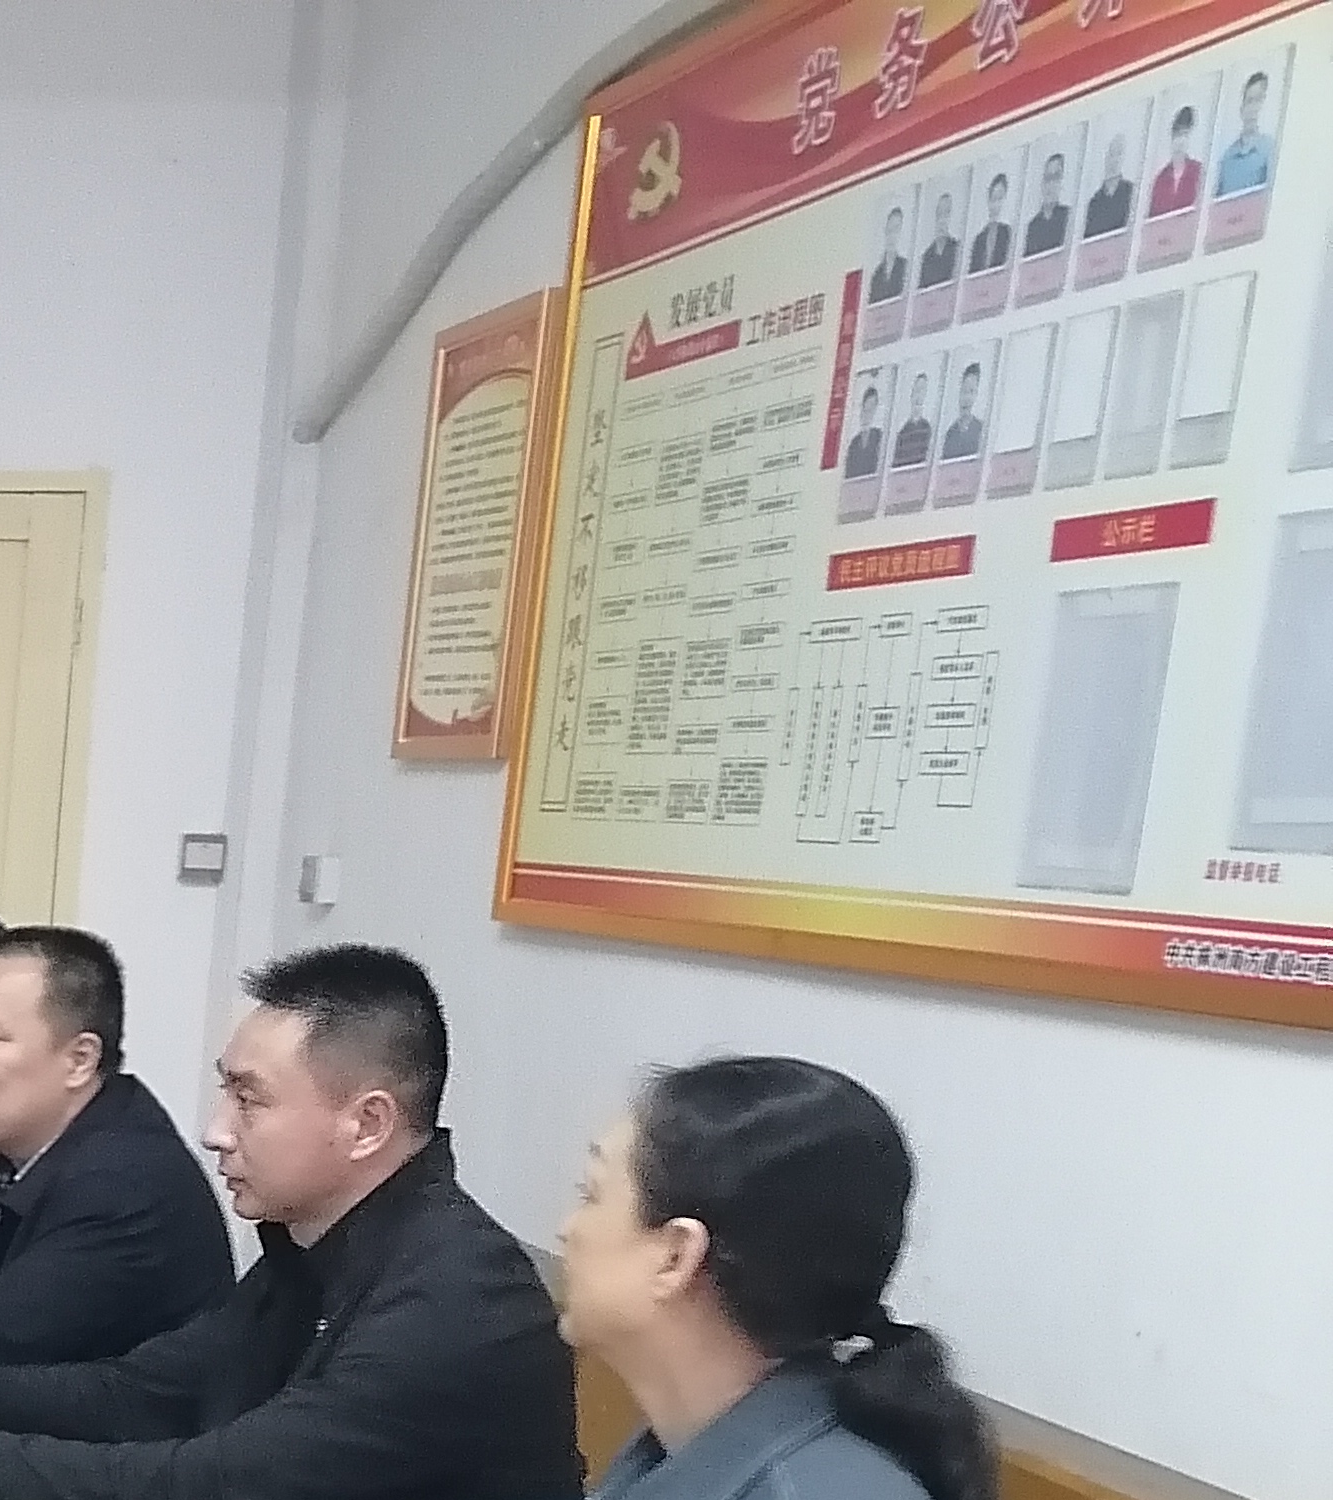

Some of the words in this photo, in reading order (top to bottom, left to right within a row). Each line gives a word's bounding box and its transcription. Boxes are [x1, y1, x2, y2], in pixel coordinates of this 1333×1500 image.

[792, 0, 1124, 155] 党务公
[1102, 514, 1158, 548] 公示栏
